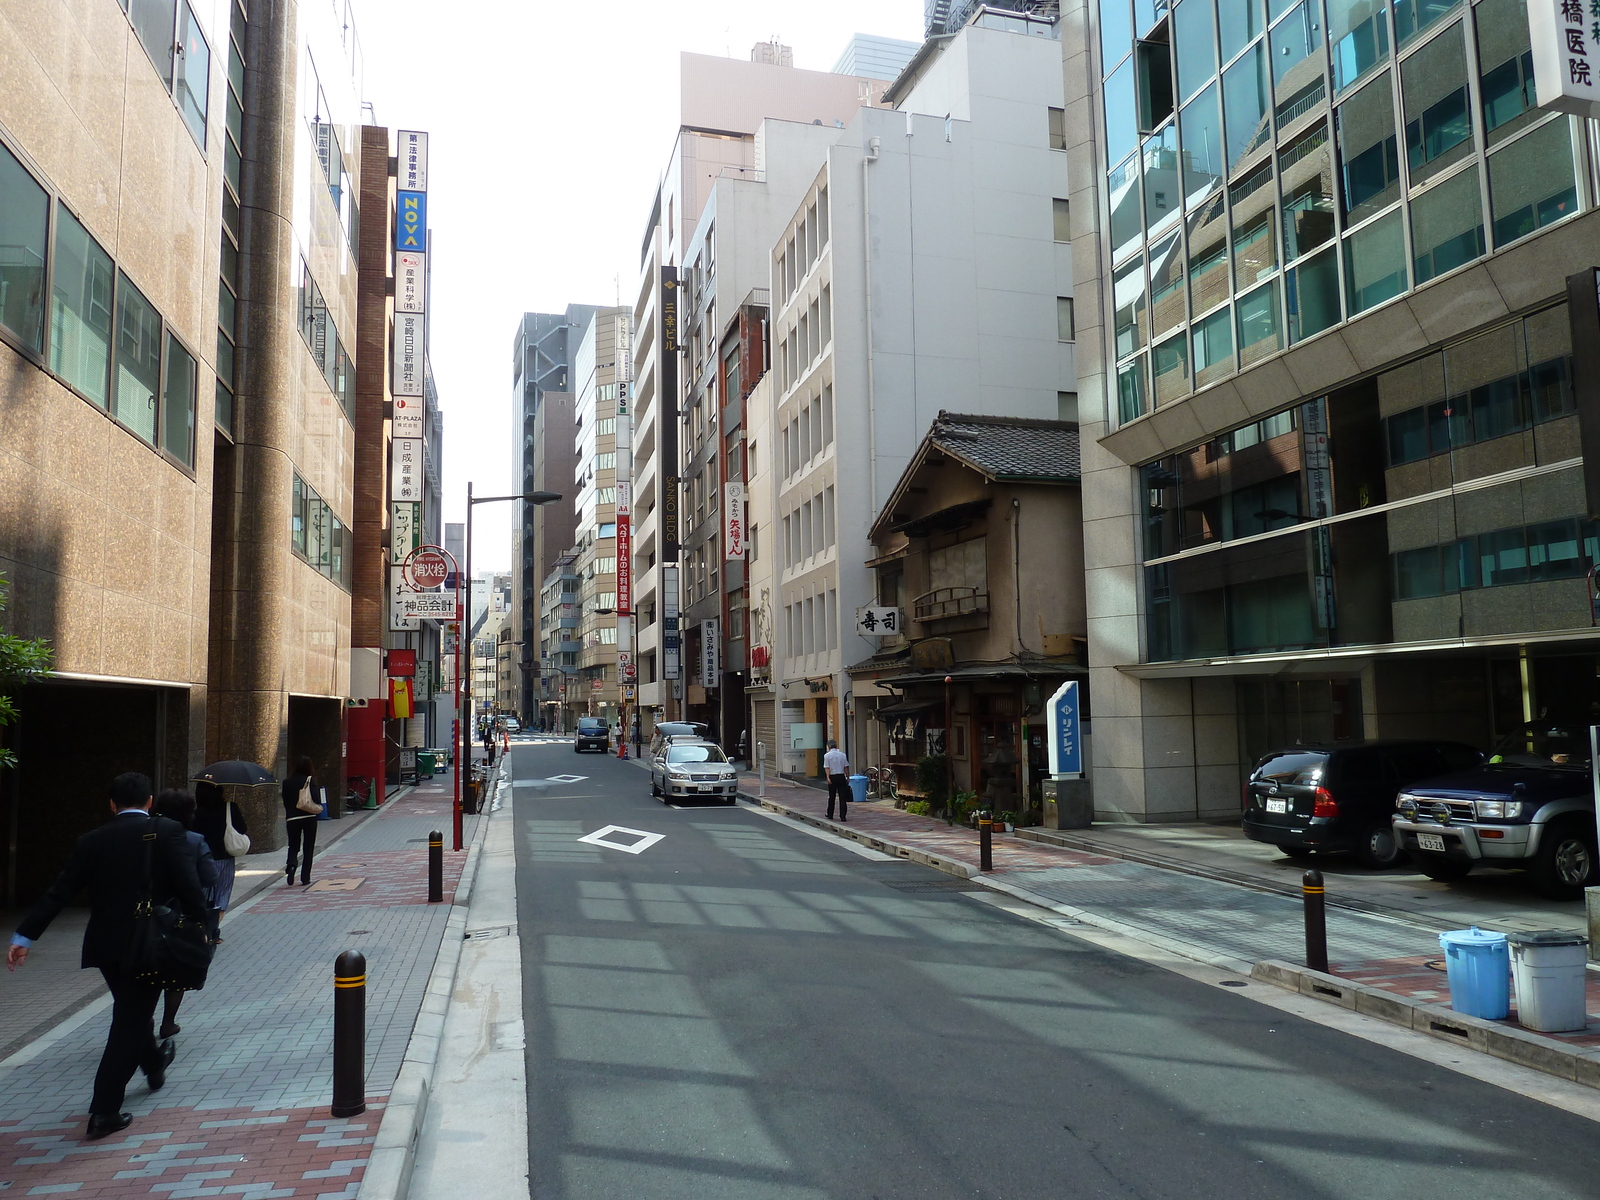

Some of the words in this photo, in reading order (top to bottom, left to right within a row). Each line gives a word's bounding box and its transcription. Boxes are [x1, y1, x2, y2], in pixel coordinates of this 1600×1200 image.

[408, 134, 418, 188] 第一法律事務所
[404, 197, 419, 246] NOVA
[664, 302, 676, 352] 三幸ビル
[404, 317, 414, 382] 宮崎日日新聞社
[666, 476, 676, 512] SANKO
[729, 518, 744, 556] 矢場とん
[414, 562, 446, 577] 消火栓
[619, 523, 628, 609] ベターホームのお料理教室
[404, 600, 453, 612] 神品会計
[861, 610, 896, 632] 寿司
[1062, 718, 1073, 756] リンレイ
[1424, 840, 1443, 850] 63-28
